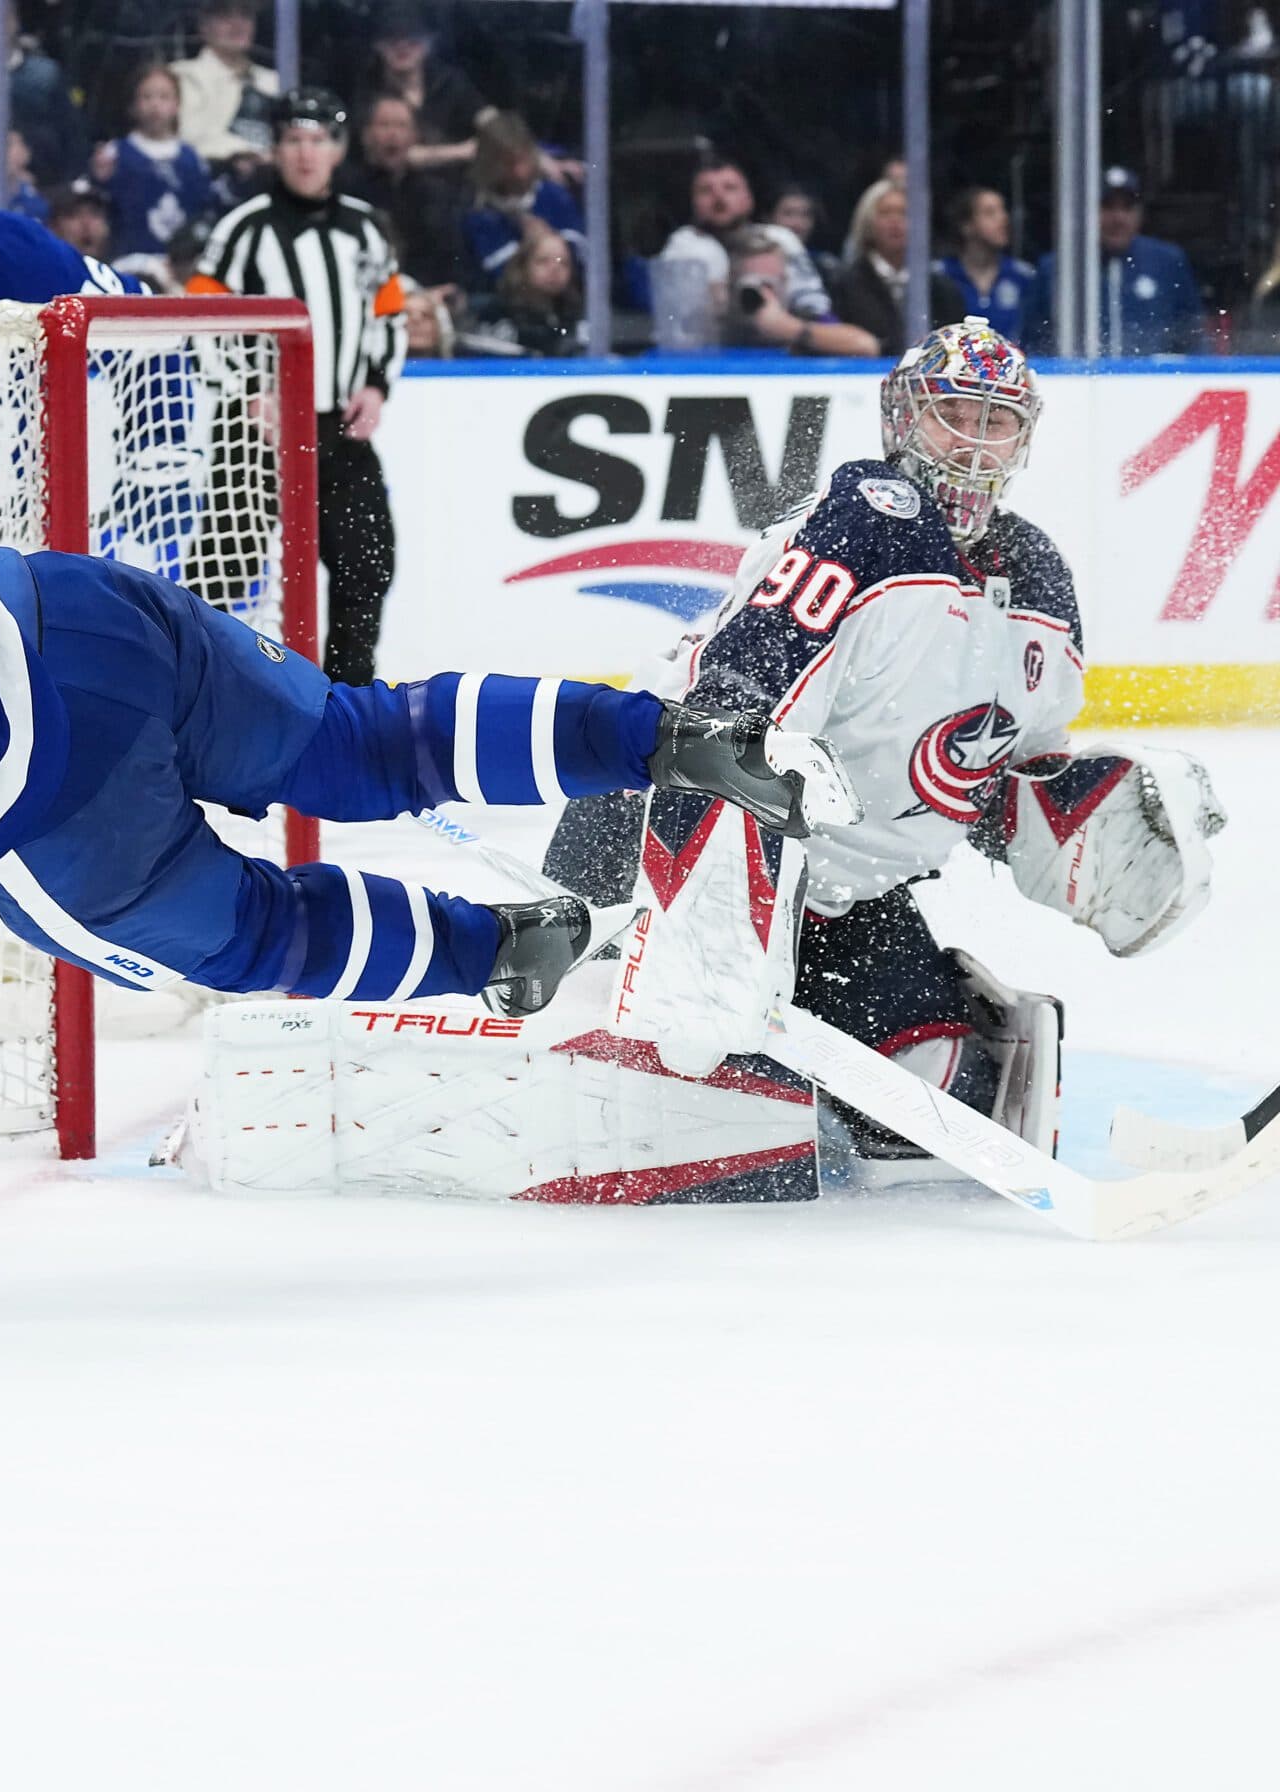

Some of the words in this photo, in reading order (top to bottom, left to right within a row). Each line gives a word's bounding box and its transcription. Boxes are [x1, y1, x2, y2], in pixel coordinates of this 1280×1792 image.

[511, 394, 831, 539] SN
[748, 546, 859, 633] 90
[103, 954, 154, 977] CCM
[616, 909, 652, 1024] TRUE
[350, 1011, 525, 1038] TRUE
